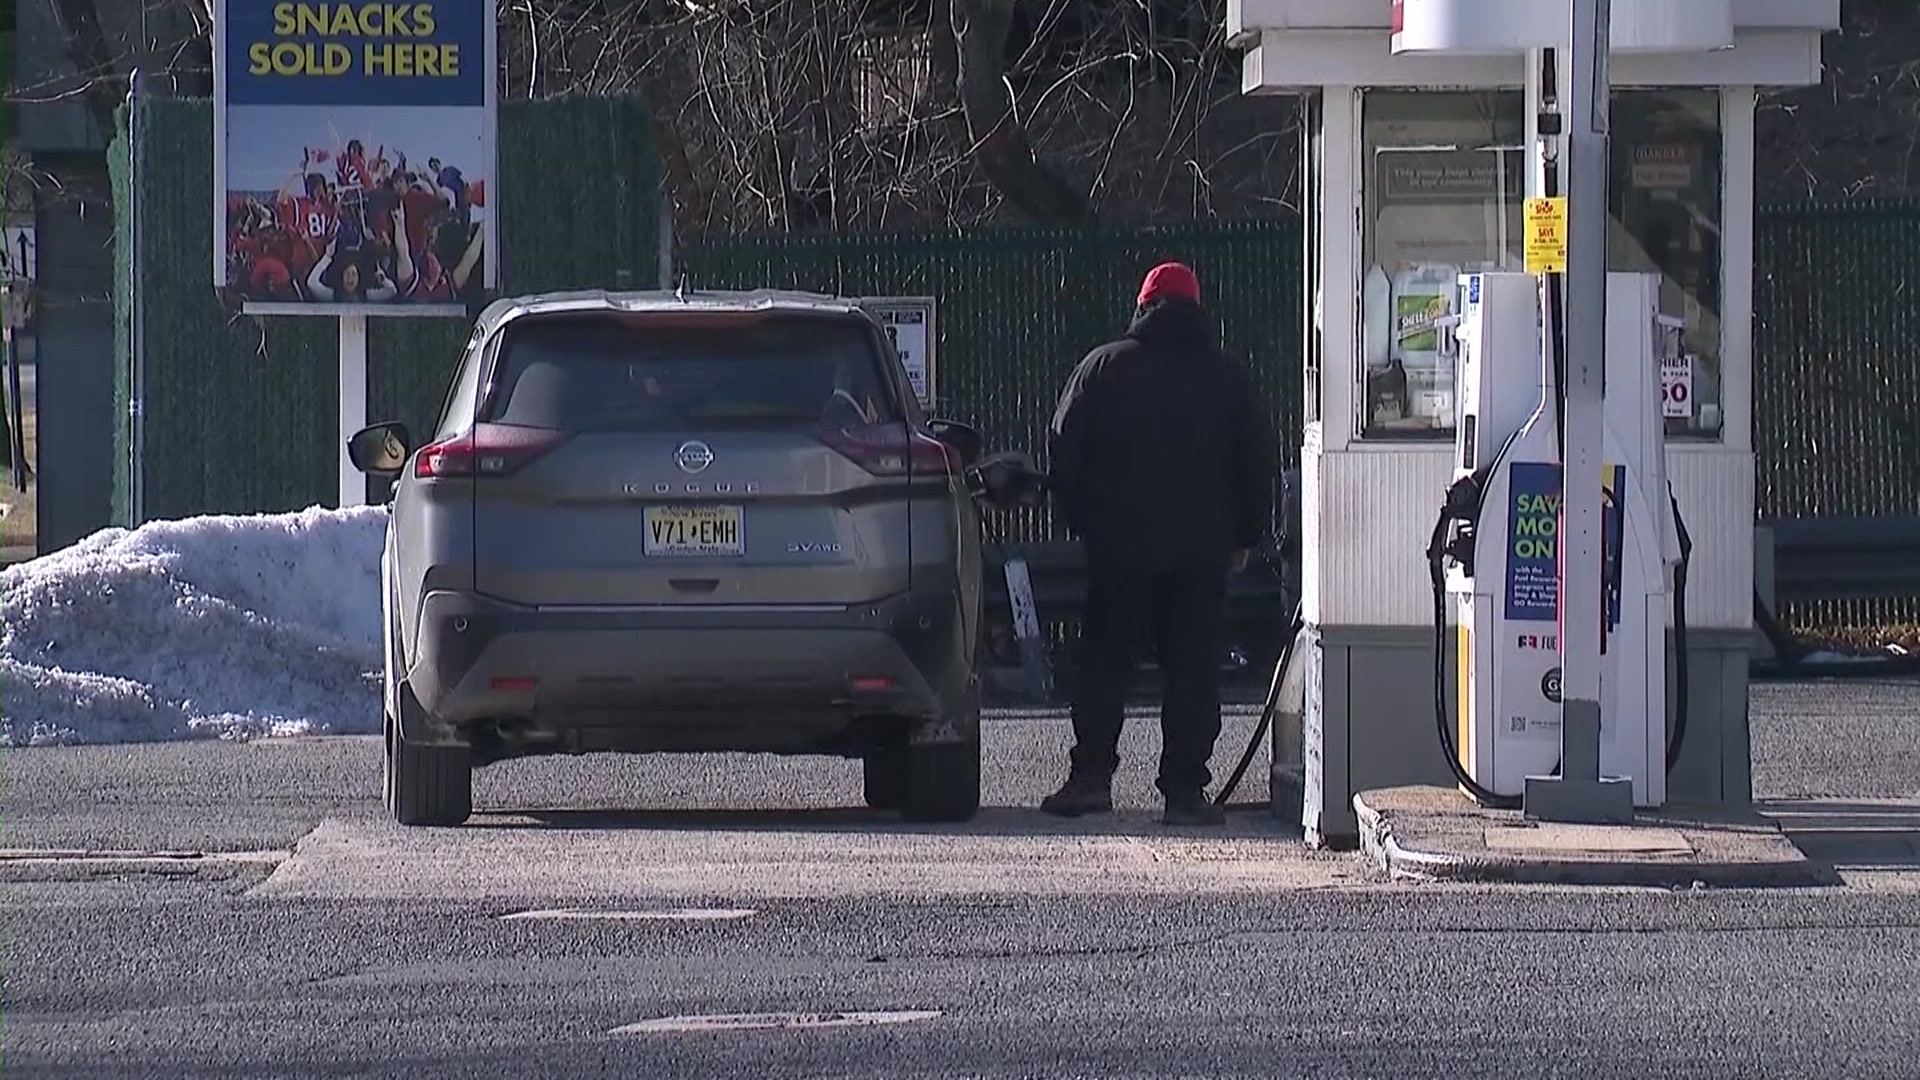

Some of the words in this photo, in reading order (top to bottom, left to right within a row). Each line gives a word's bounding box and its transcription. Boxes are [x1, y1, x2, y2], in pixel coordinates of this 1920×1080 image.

[273, 2, 436, 36] SNACKS
[249, 43, 351, 76] SOLD
[364, 43, 459, 76] HERE
[308, 213, 326, 236] 81
[623, 482, 760, 494] ROGUE
[1517, 493, 1560, 513] SAV
[1516, 517, 1557, 536] MO
